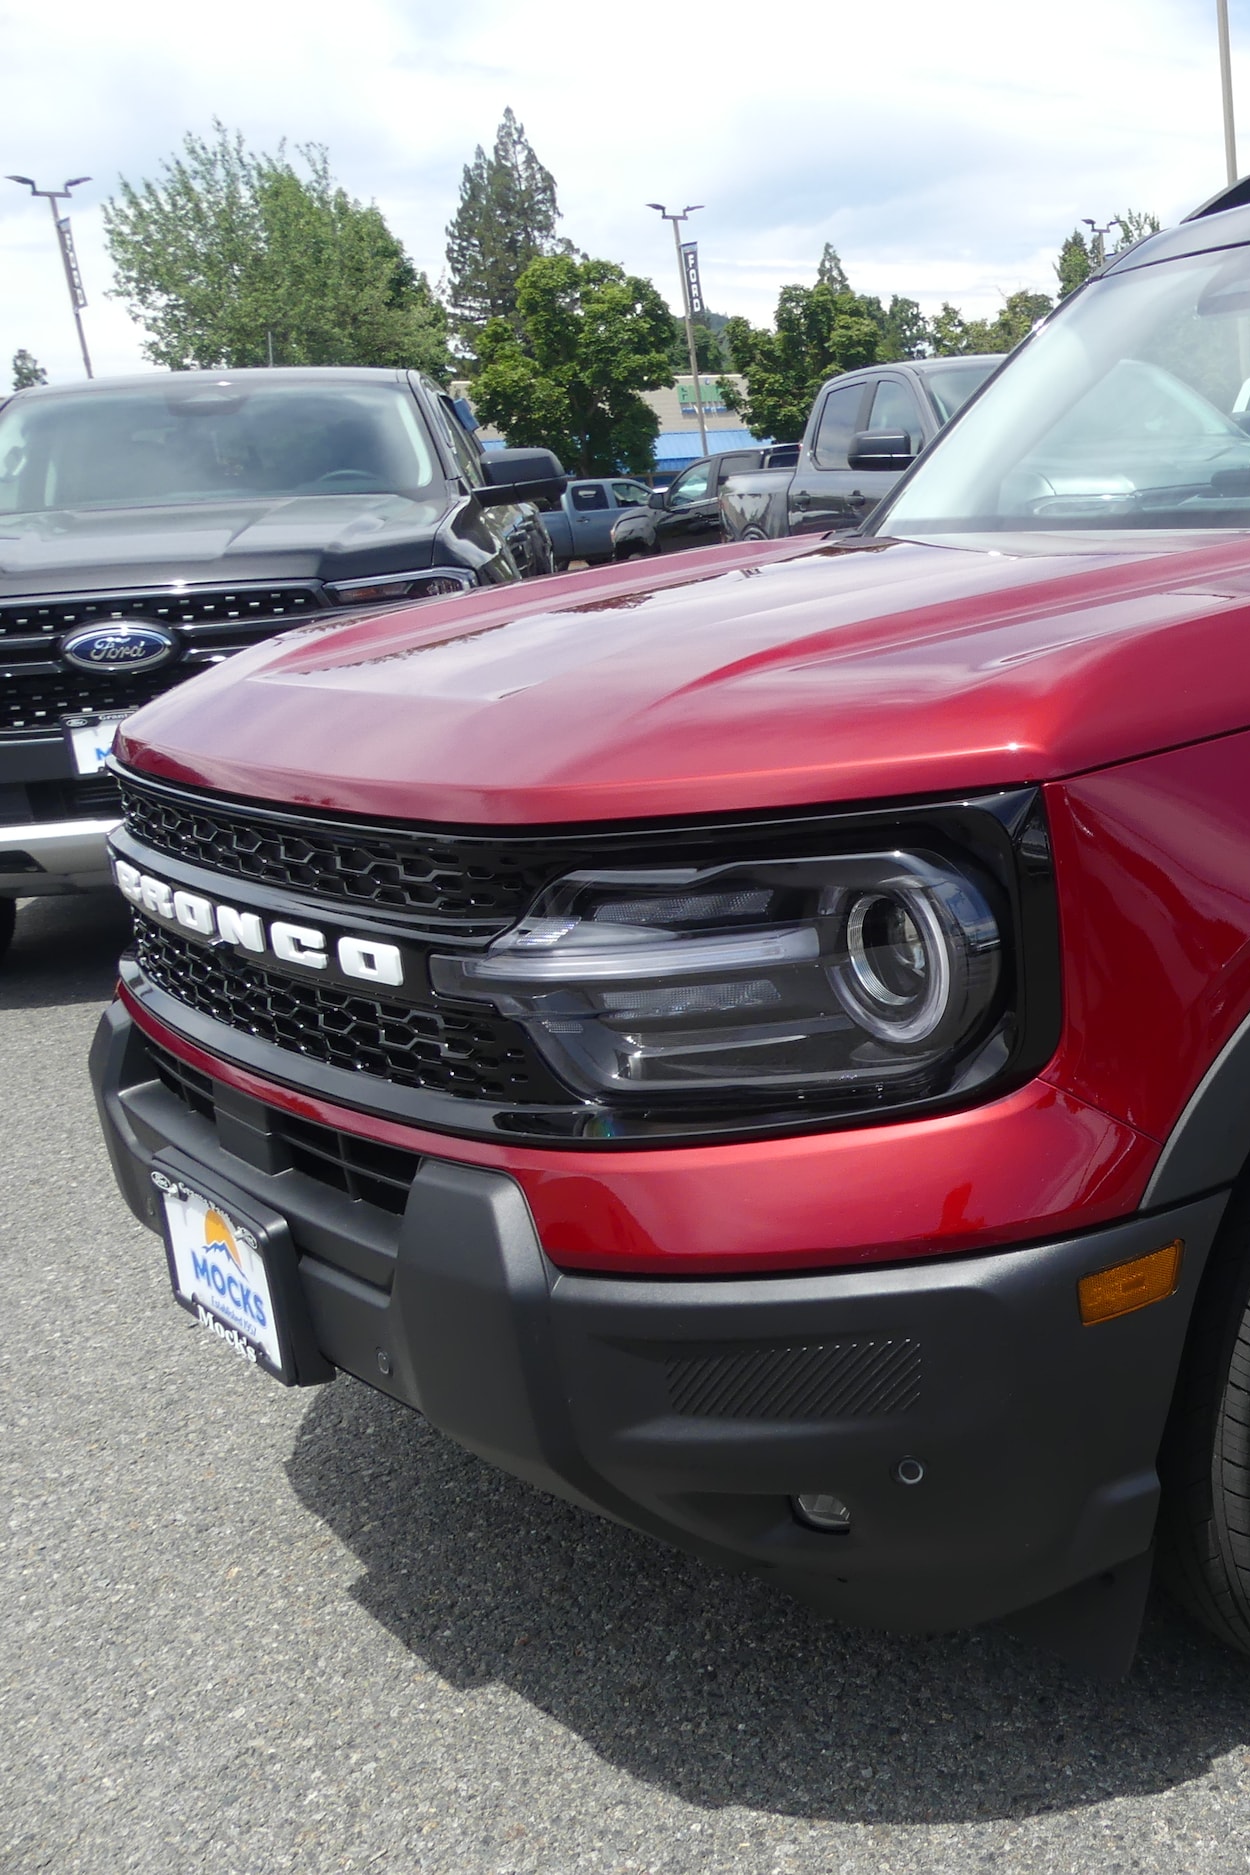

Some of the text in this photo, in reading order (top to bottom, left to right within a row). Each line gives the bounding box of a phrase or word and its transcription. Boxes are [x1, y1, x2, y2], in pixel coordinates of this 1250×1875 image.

[687, 253, 701, 313] FORD
[90, 637, 146, 660] Ford
[115, 860, 404, 987] BRONCO
[191, 1249, 266, 1327] MOCKS
[197, 1305, 257, 1363] Mock's
